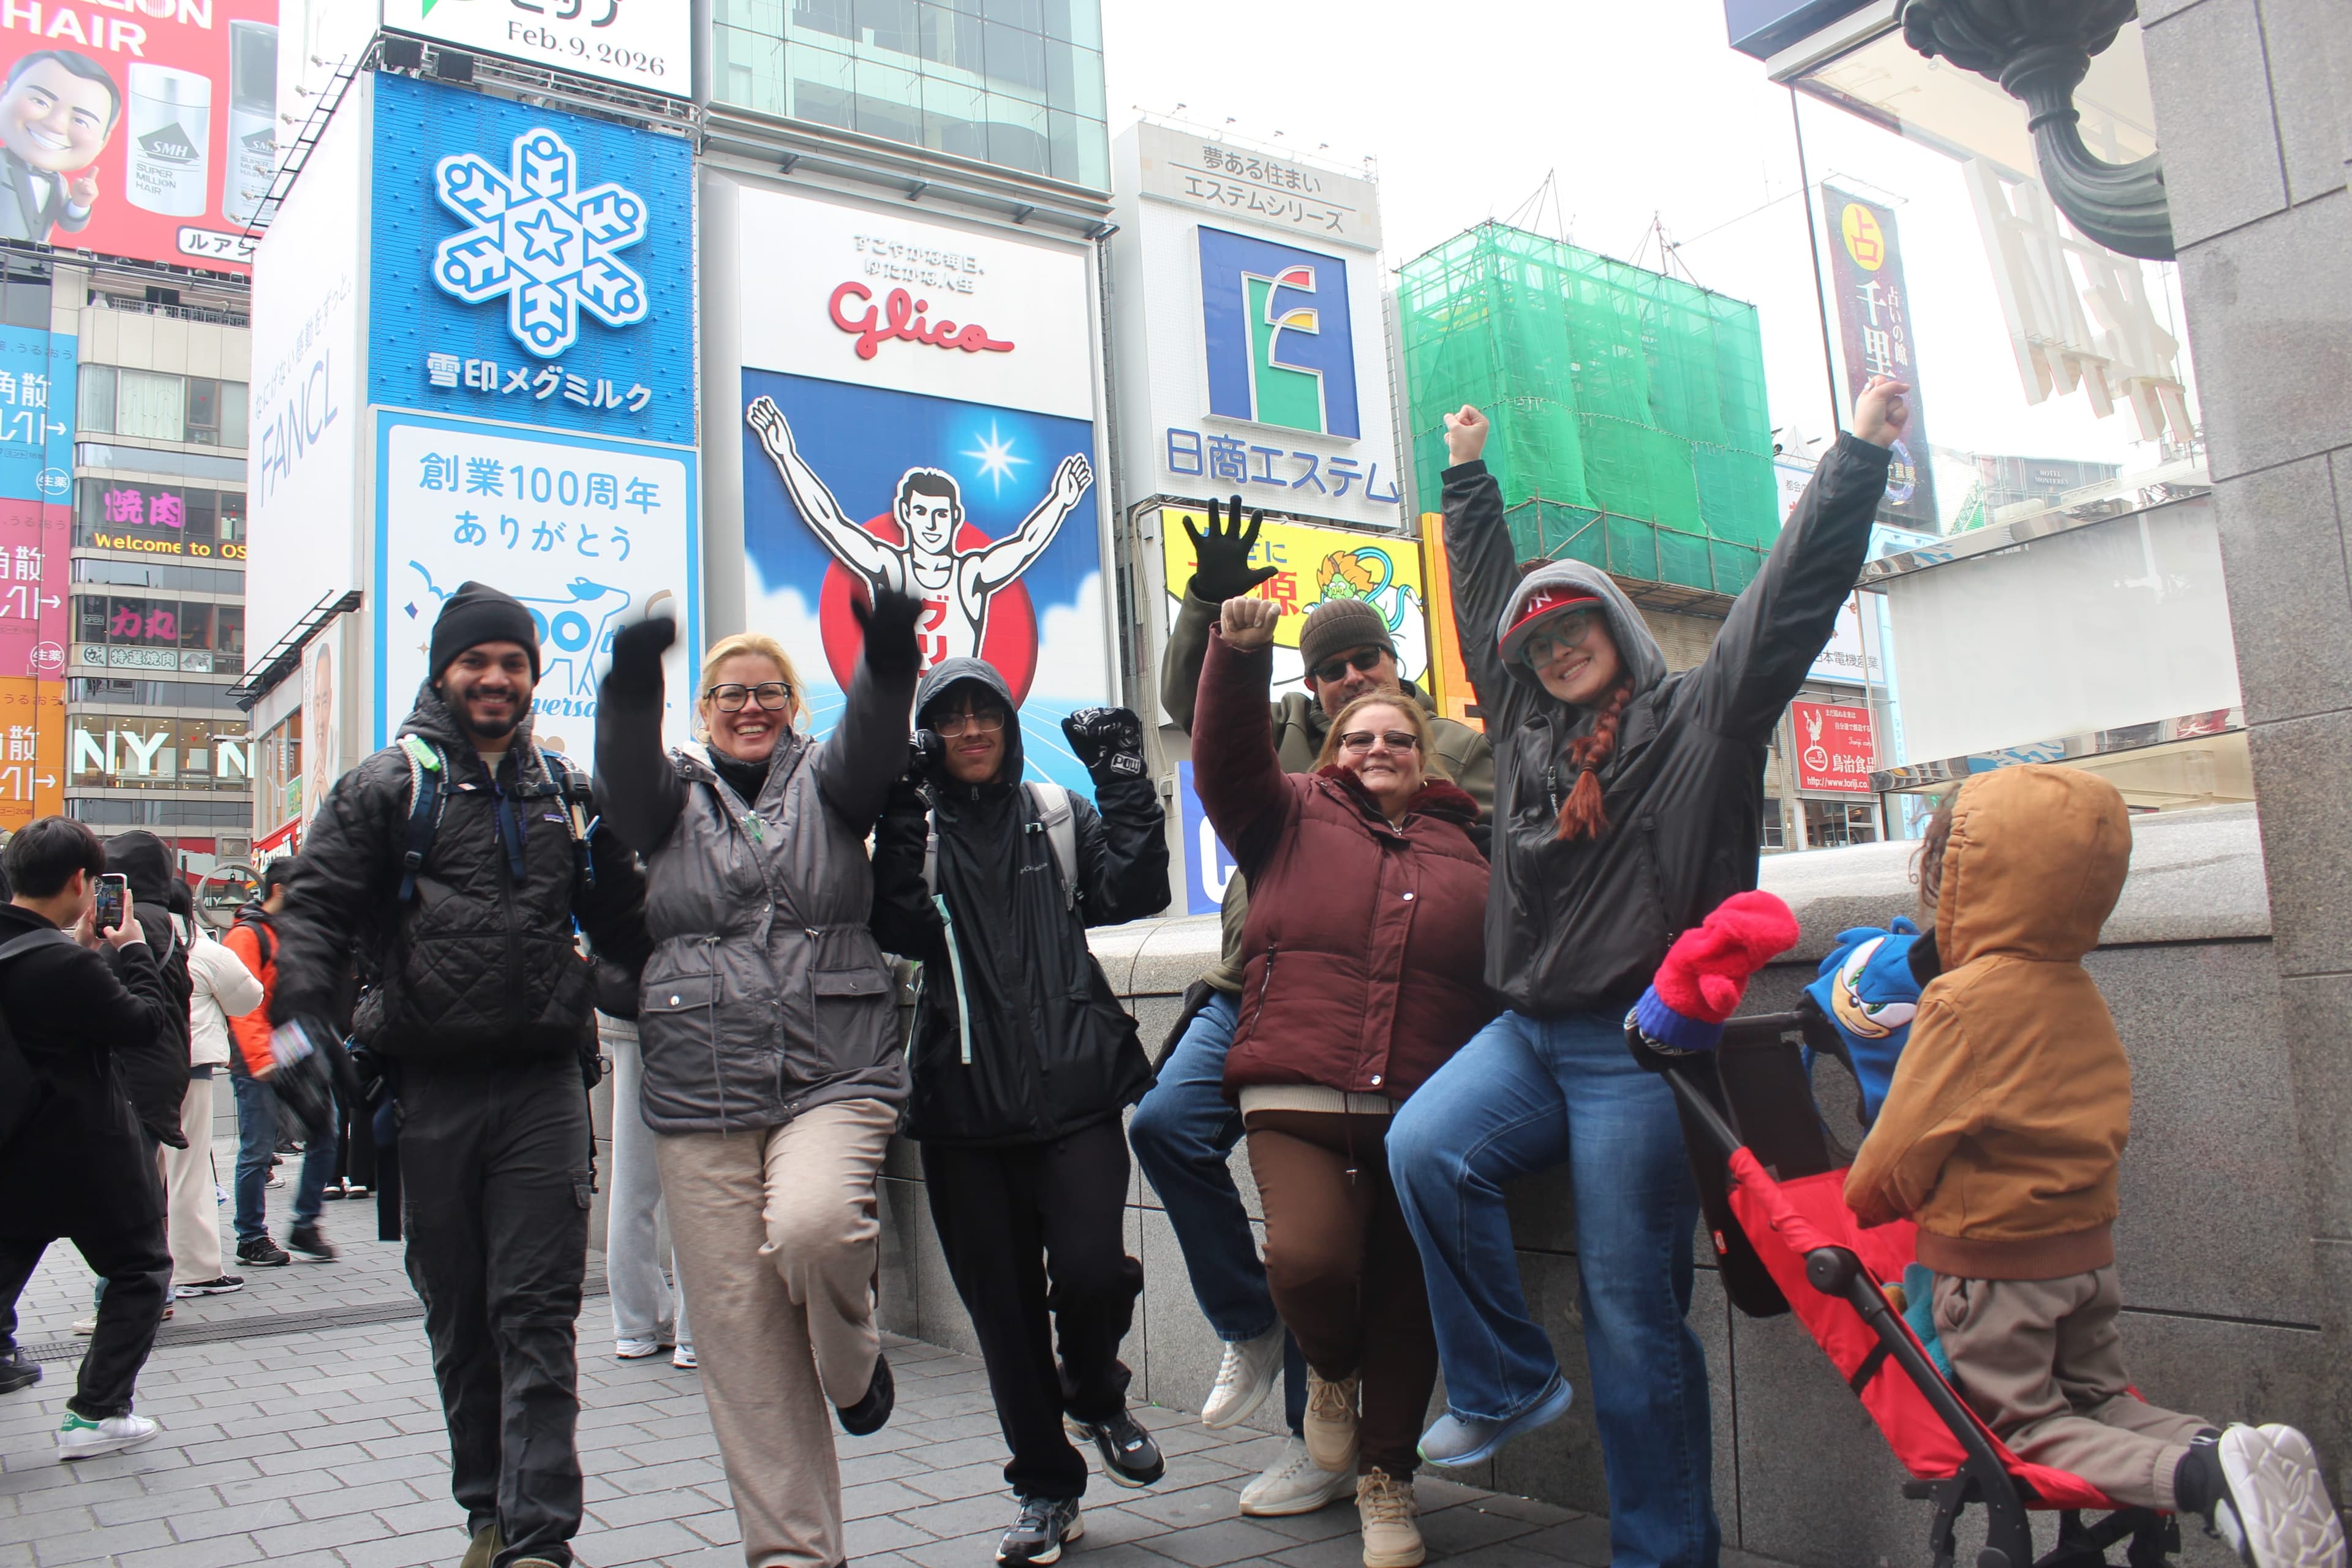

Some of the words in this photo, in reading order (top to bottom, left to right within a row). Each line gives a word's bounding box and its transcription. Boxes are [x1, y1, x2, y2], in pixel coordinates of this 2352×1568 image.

[1, 0, 146, 57] HAIR
[508, 20, 564, 52] Feb.
[569, 37, 590, 61] 9,
[597, 43, 665, 76] 2026
[137, 164, 173, 178] SUPER
[153, 141, 188, 157] SMH
[1202, 146, 1321, 193] 夢ある住まい
[135, 172, 176, 189] MILLION
[135, 181, 162, 195] HAIR
[1185, 176, 1344, 233] エステムシリーズ
[854, 235, 985, 275] すこやかな毎日、
[1851, 207, 1879, 263] 占
[864, 258, 974, 294] ゆたかな人生
[829, 281, 1015, 360] Glico
[1856, 280, 1897, 383] 千里
[1887, 285, 1908, 366] 占いの館
[427, 352, 653, 413] 雪印メグミルク
[261, 348, 338, 508] FANCL
[419, 452, 662, 514] 創業100周年
[1166, 428, 1400, 504] 日商エステム
[104, 488, 186, 528] 焼肉
[94, 532, 181, 554] Welcome
[189, 542, 210, 556] to
[454, 511, 632, 562] ありがとう
[110, 607, 178, 640] 力丸
[917, 595, 949, 678] グリ
[111, 648, 176, 667] 特選焼肉
[0, 725, 39, 761] 散
[1113, 755, 1140, 772] POW
